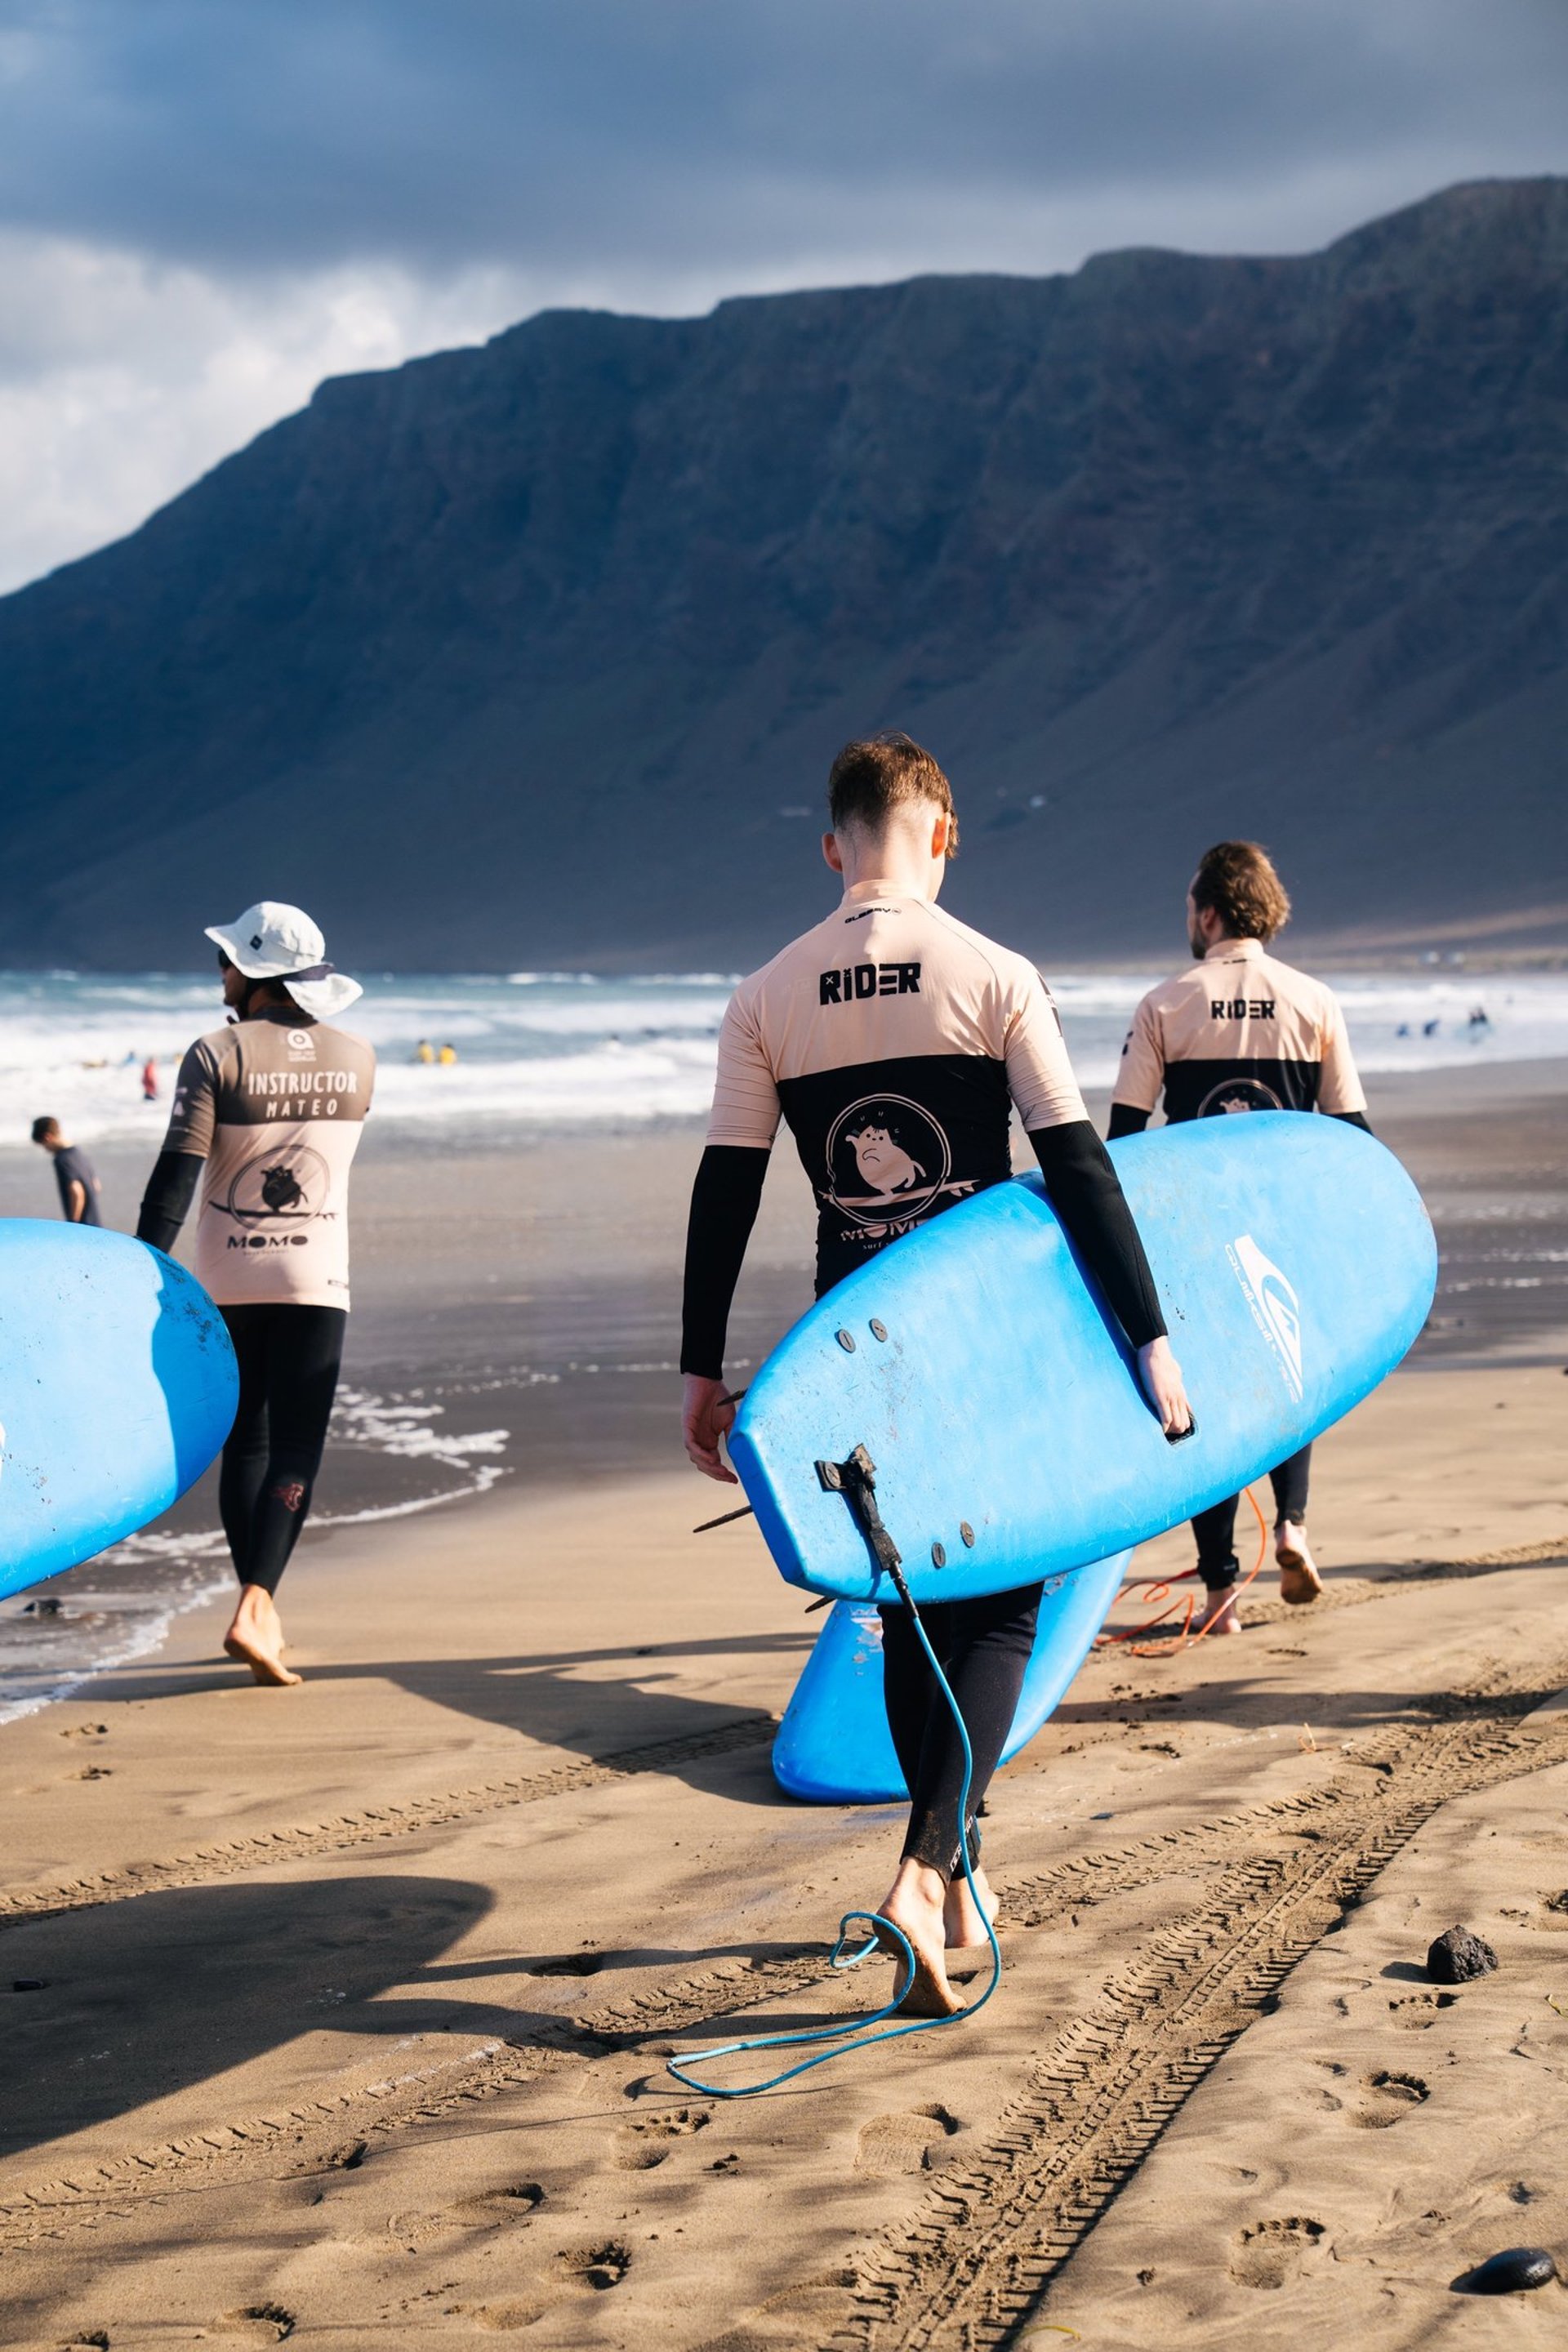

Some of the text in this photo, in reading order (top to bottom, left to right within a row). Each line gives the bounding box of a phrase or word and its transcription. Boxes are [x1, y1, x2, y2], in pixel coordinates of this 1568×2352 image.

[249, 1071, 357, 1095] INSTRUCTOR
[266, 1099, 337, 1118] MATEO
[840, 1219, 929, 1241] MOM
[228, 1236, 308, 1249] MOMO
